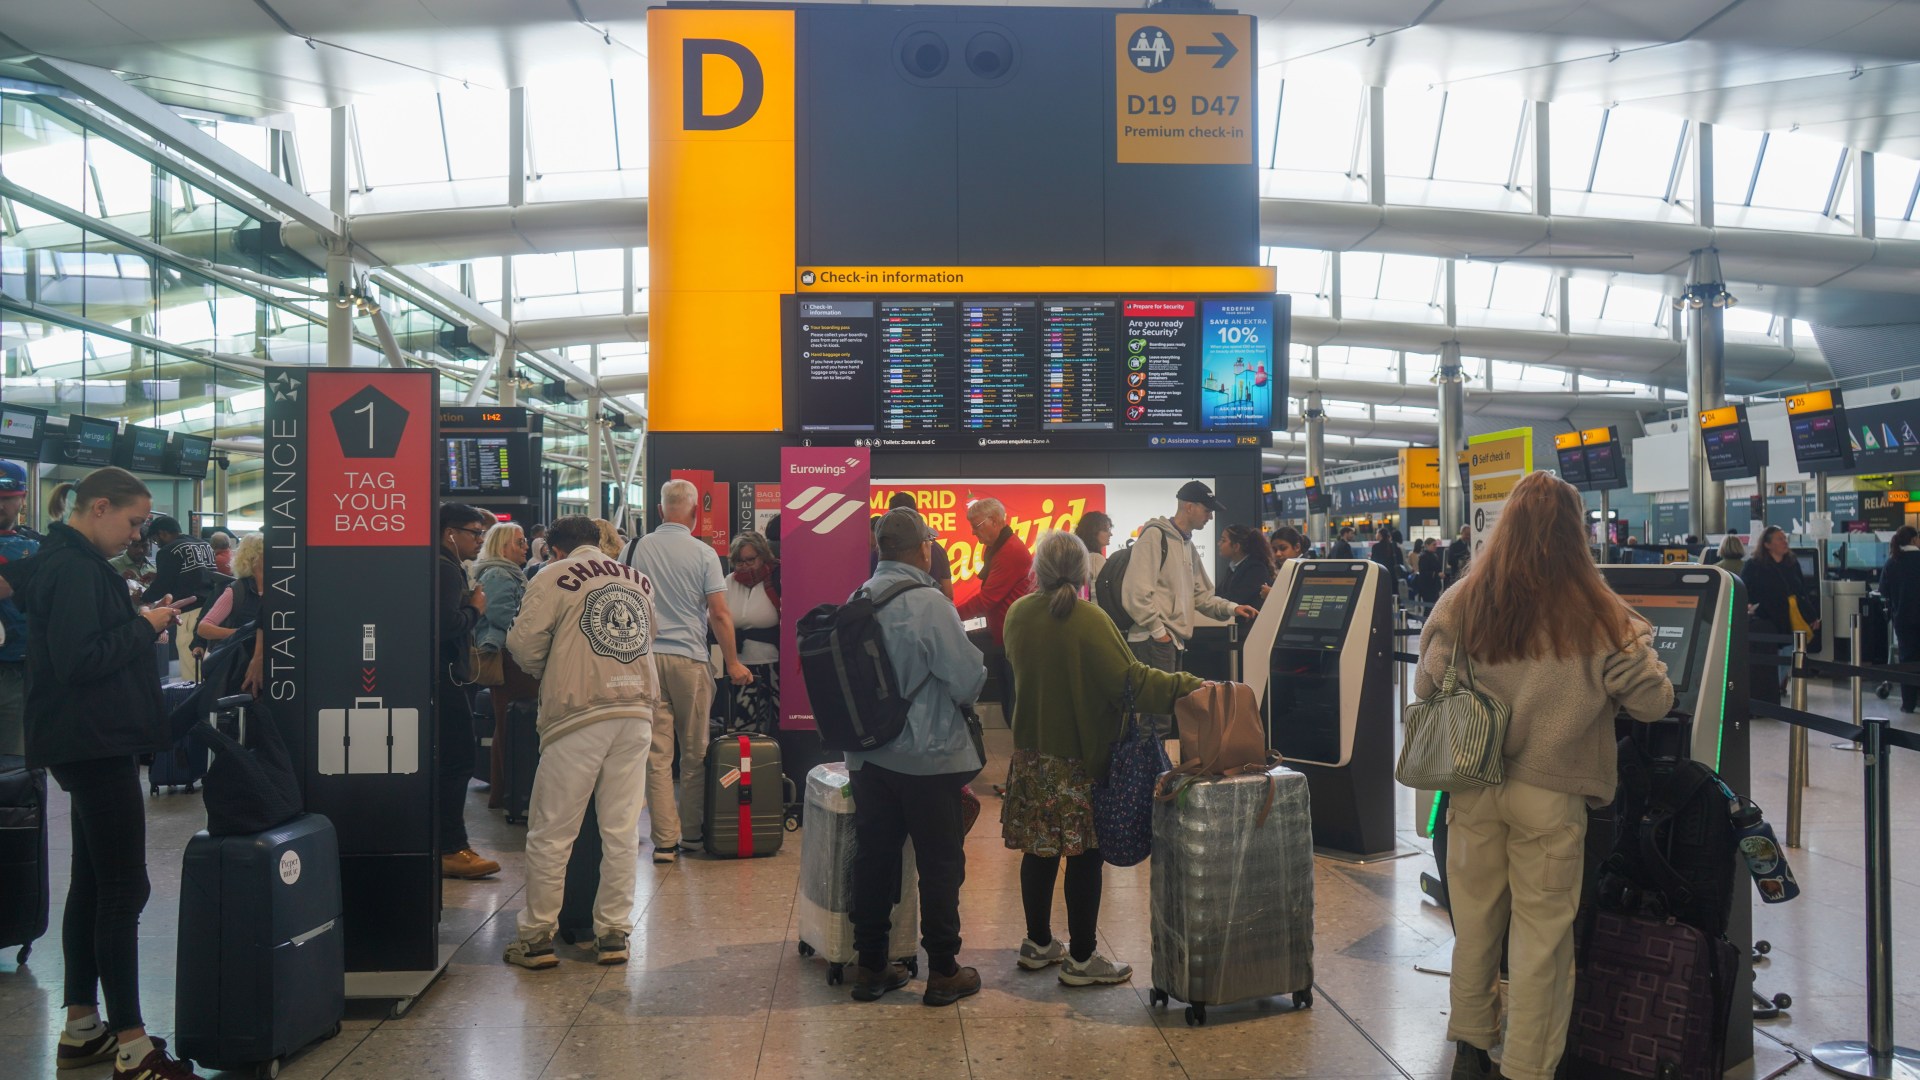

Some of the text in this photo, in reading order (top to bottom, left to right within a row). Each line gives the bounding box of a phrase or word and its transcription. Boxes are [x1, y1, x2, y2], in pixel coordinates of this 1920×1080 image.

[681, 38, 765, 131] D
[1126, 95, 1241, 117] D19 D47
[1124, 125, 1244, 139] Premium check-in
[820, 270, 964, 286] Check-in information
[1144, 321, 1160, 329] you
[1161, 320, 1183, 329] ready
[1142, 329, 1178, 337] Security?
[1218, 327, 1259, 343] 10%
[1796, 398, 1805, 406] D5
[482, 413, 501, 421] 11:42
[1708, 413, 1715, 421] D4
[354, 401, 374, 450] 1
[1479, 450, 1510, 464] Self check in
[790, 464, 846, 476] Eurowings
[344, 472, 395, 489] TAG
[1474, 483, 1483, 491] Step
[333, 493, 406, 510] YOUR
[704, 495, 710, 511] 2
[335, 514, 406, 531] BAGS
[271, 419, 297, 701] STAR ALLIANCE
[557, 560, 651, 595] CHAOTIC
[1659, 641, 1677, 649] SAS
